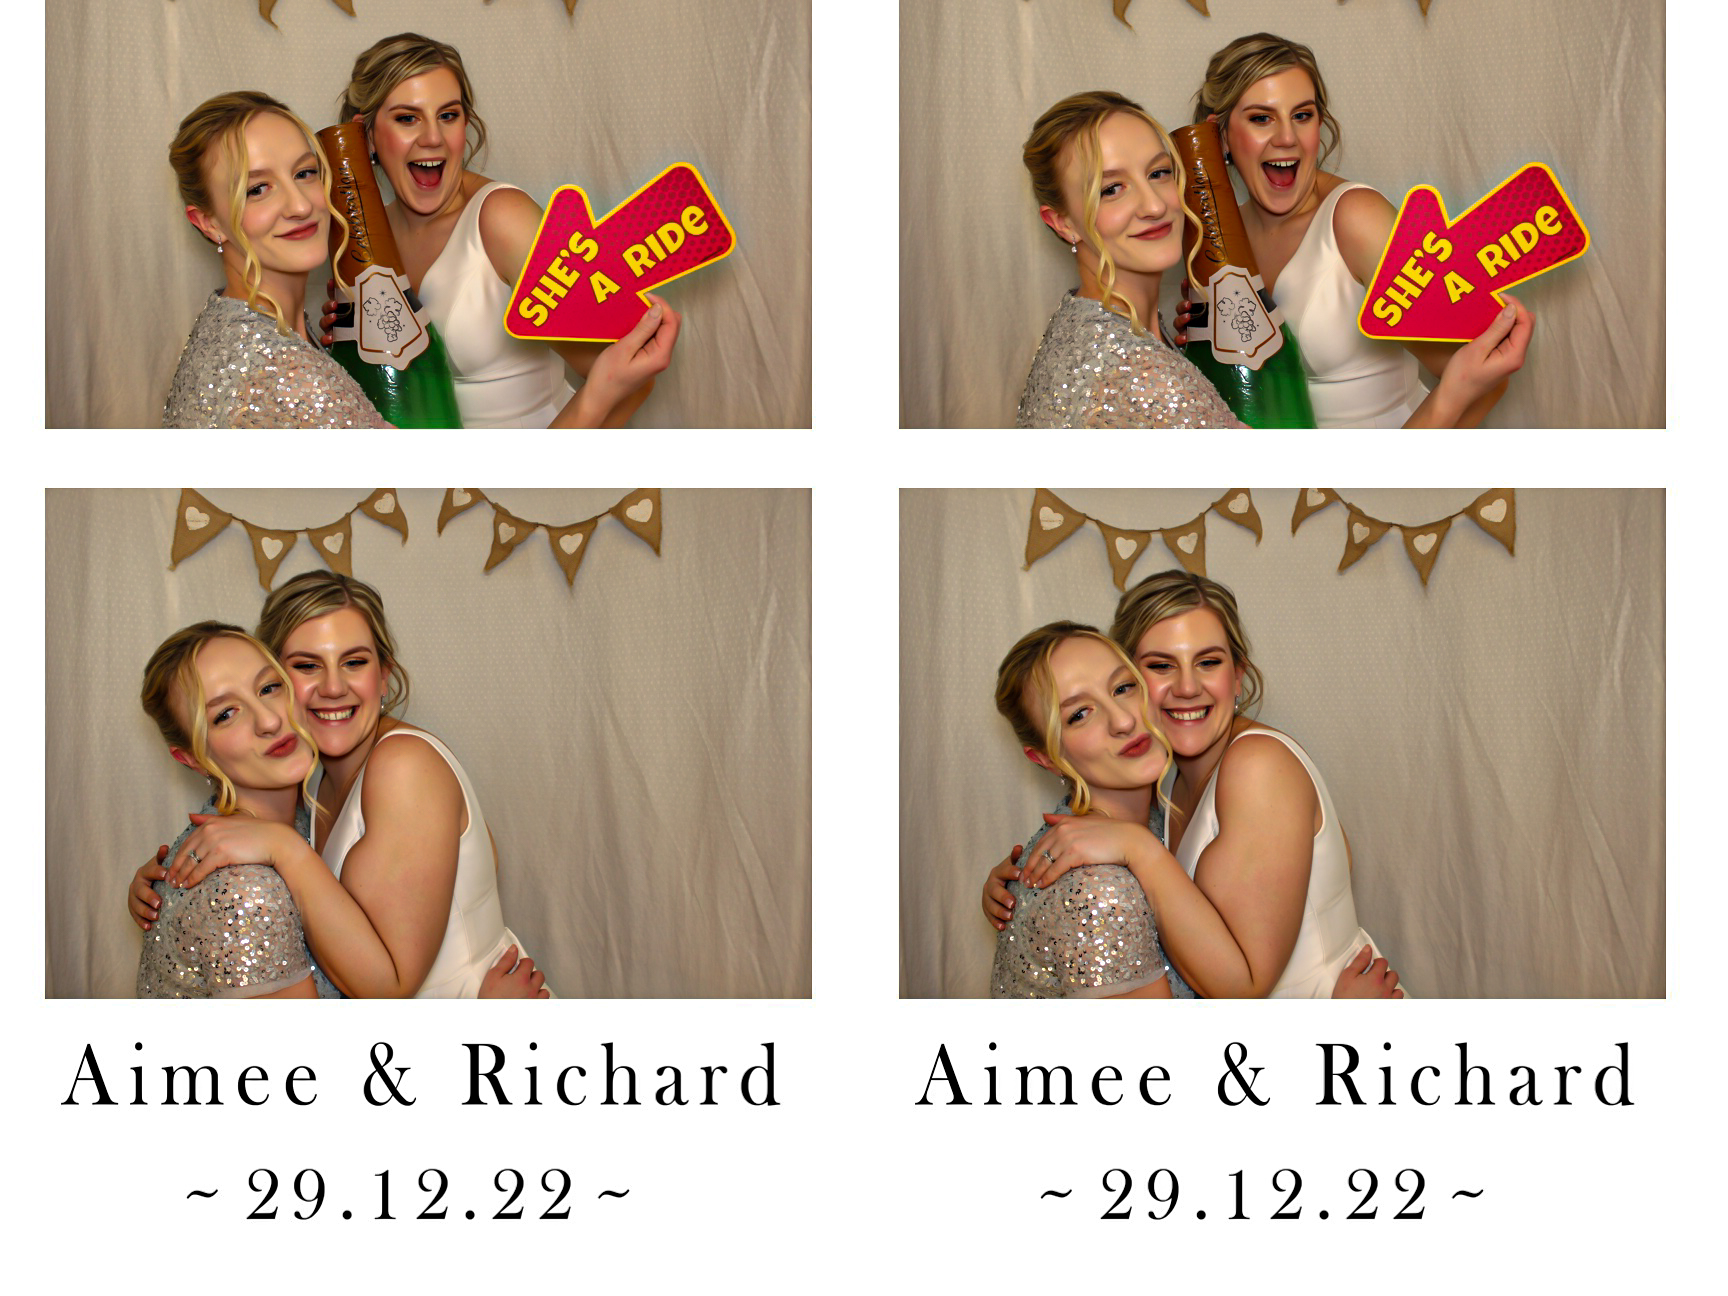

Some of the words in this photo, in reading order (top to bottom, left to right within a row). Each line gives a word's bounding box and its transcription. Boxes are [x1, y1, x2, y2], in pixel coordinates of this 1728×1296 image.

[518, 230, 599, 327] SHE'S
[589, 270, 621, 304] A
[1372, 230, 1453, 327] SHE'S
[1443, 270, 1475, 304] A
